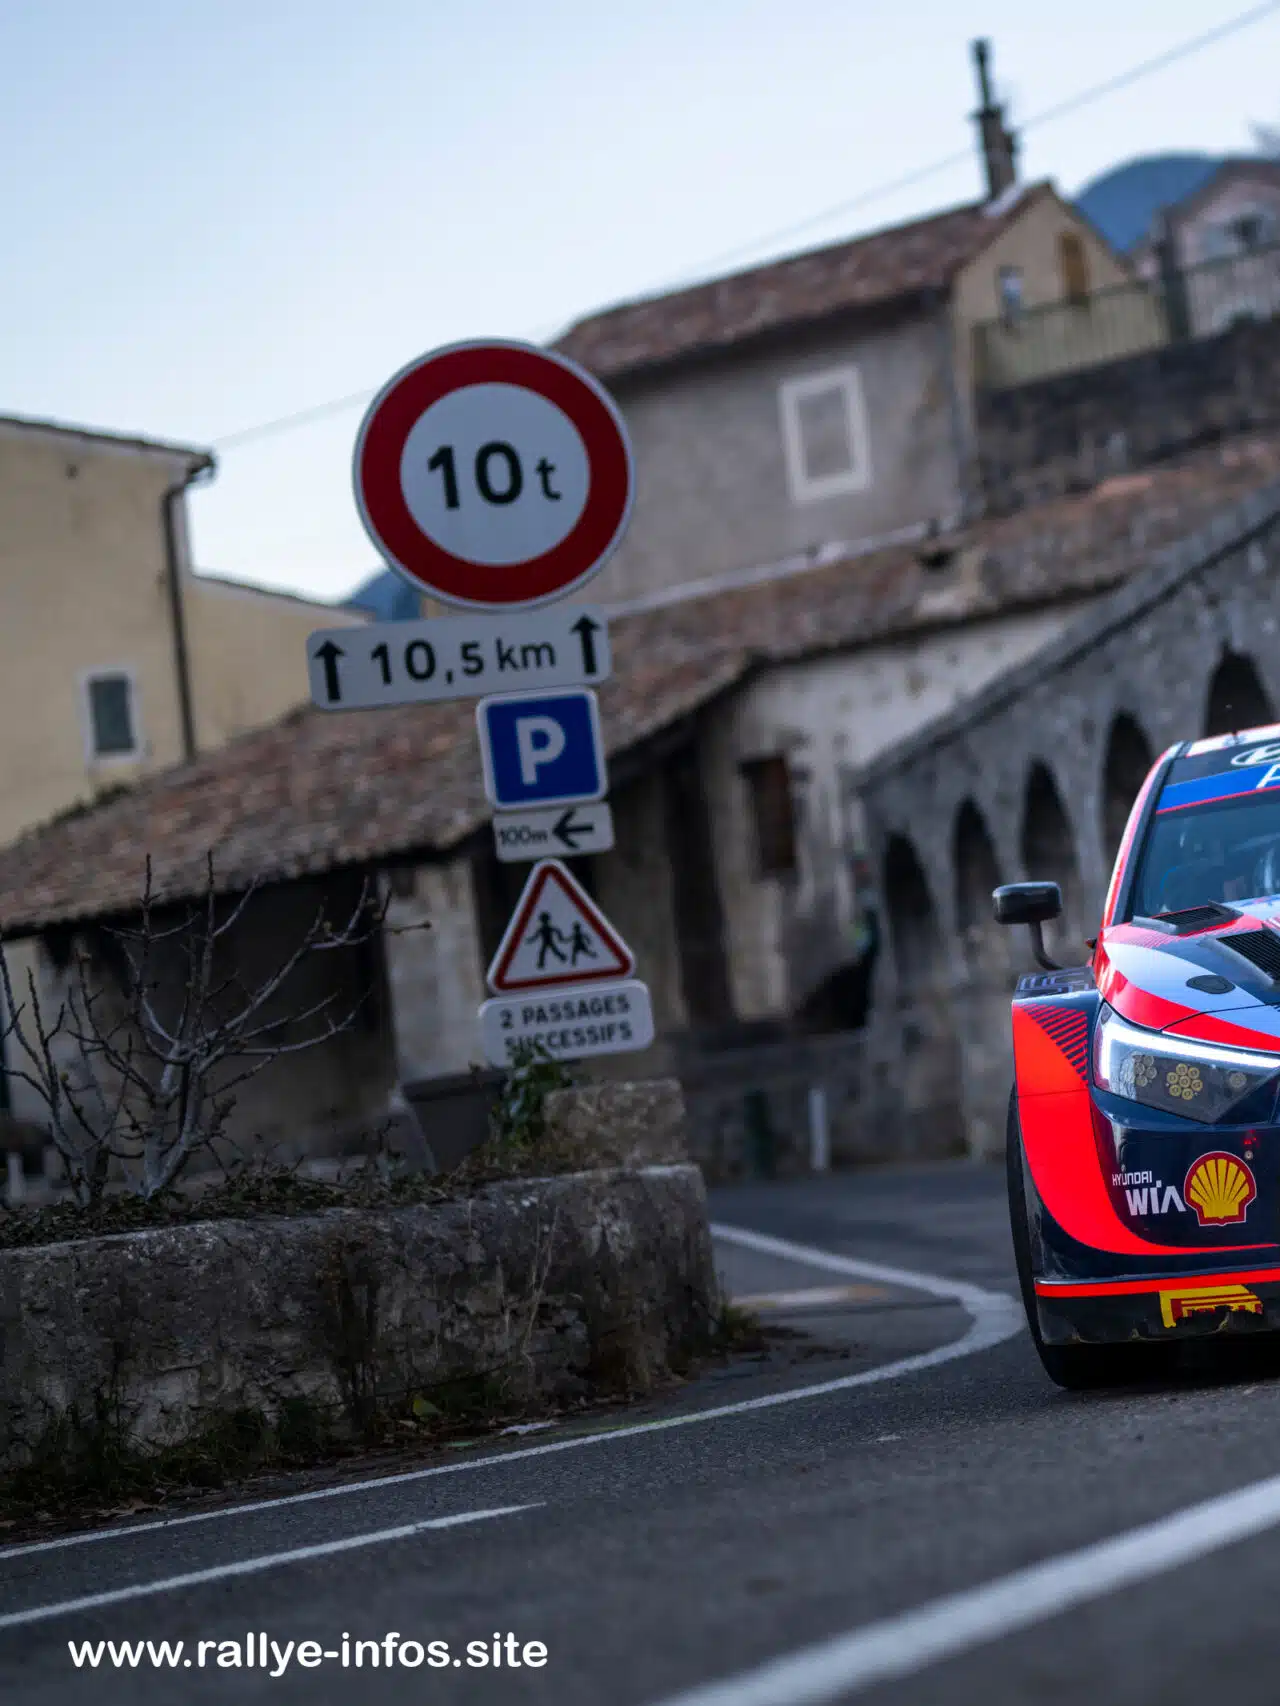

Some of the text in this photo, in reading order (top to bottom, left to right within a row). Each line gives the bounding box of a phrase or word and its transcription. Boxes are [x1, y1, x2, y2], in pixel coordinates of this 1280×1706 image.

[427, 440, 562, 510] 10 t
[370, 637, 556, 685] 10,5 km
[515, 715, 566, 785] P
[499, 825, 549, 846] 100m
[500, 994, 631, 1029] 2 PASSAGES
[1112, 1170, 1153, 1186] HYUNDAI
